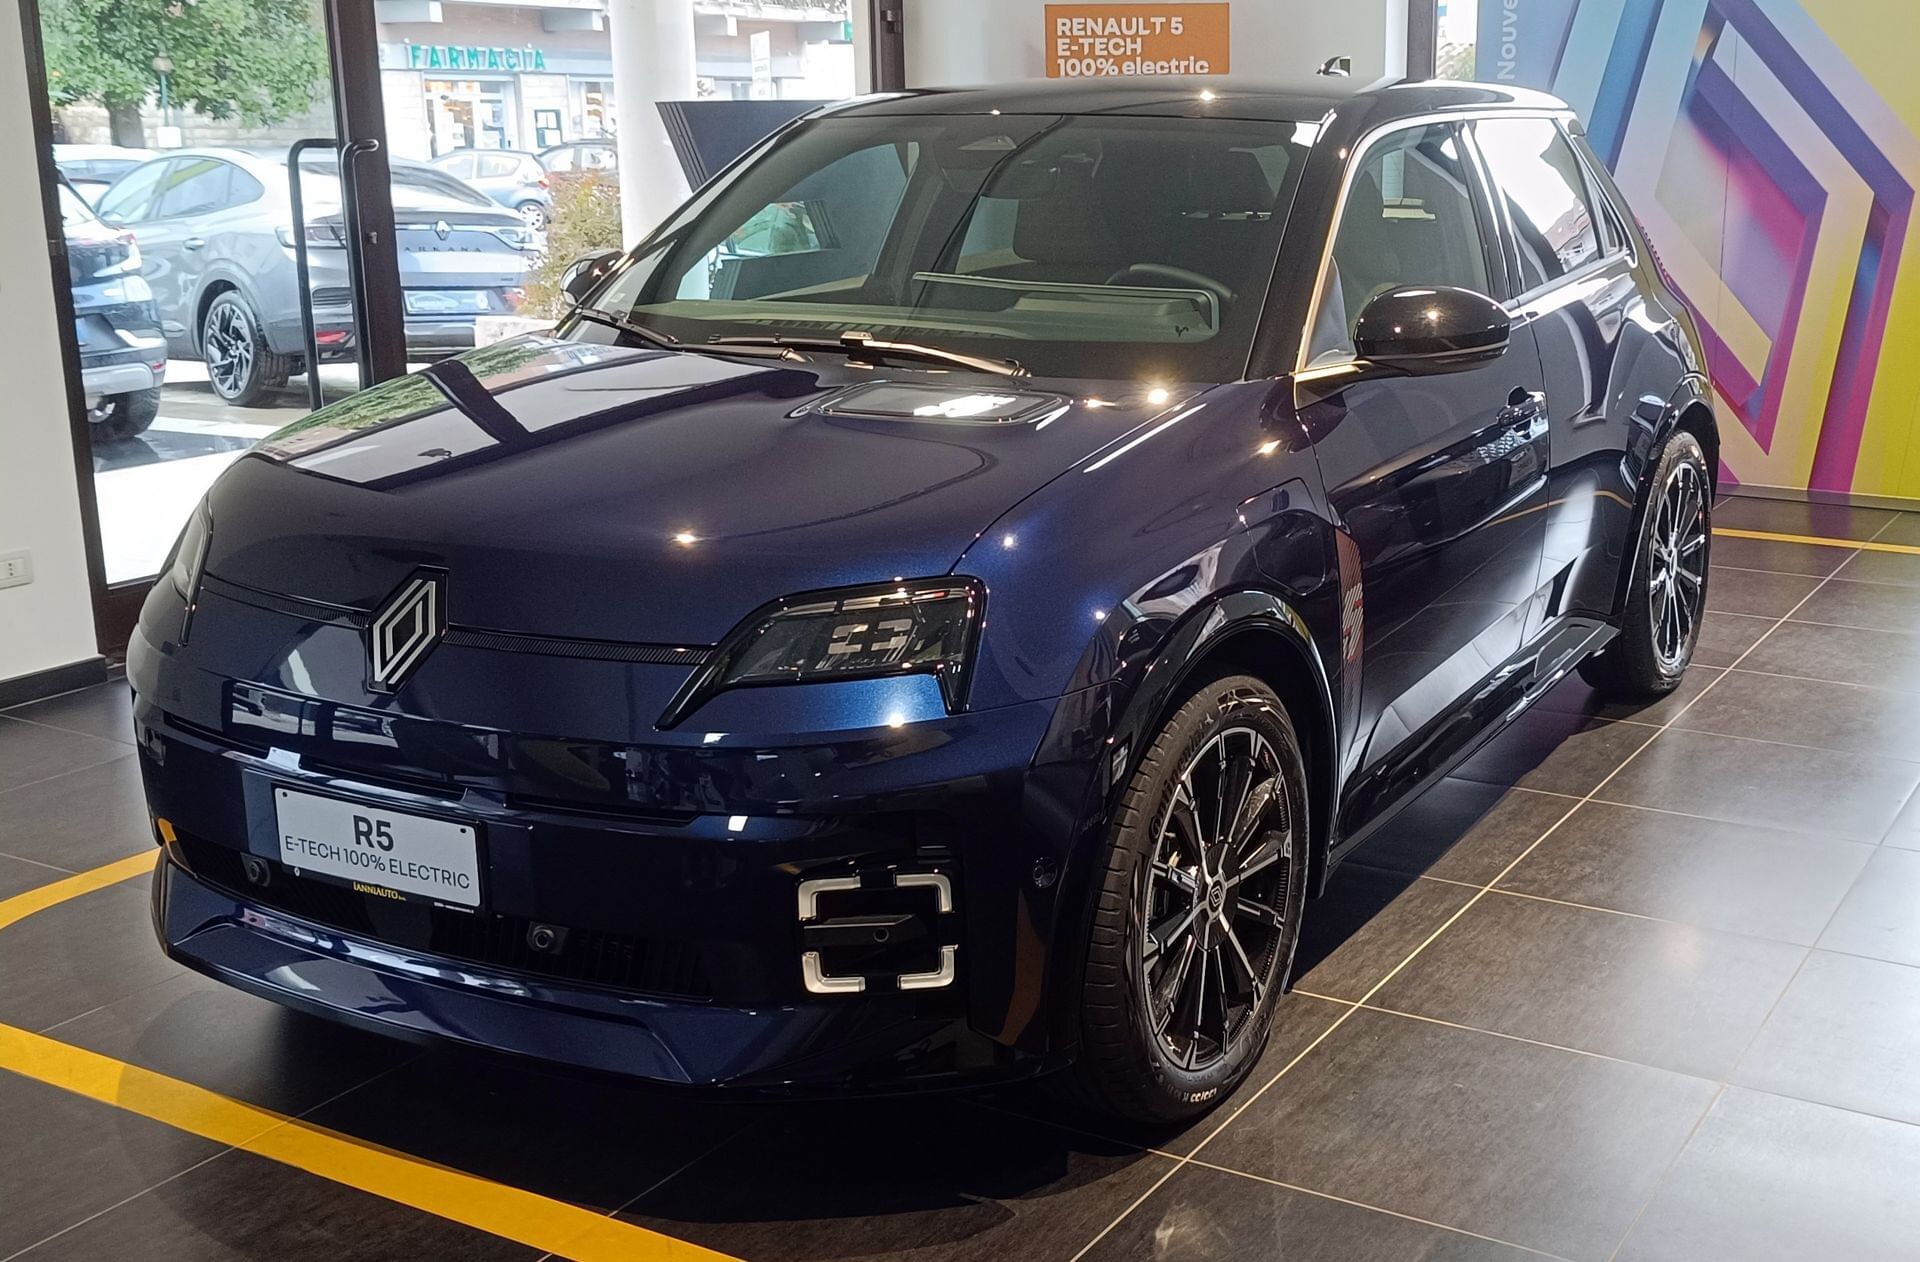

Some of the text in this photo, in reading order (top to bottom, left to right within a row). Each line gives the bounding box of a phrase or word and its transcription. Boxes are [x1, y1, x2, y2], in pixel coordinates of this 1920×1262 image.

[1056, 17, 1184, 36] RENAULT 5
[1057, 37, 1142, 56] E-TECH
[1497, 0, 1519, 80] Nouve
[410, 44, 546, 70] FARMACIA
[1057, 56, 1210, 77] 100% electric
[353, 814, 394, 850] R5
[285, 835, 470, 889] E-TECH 100% ELECTRIC
